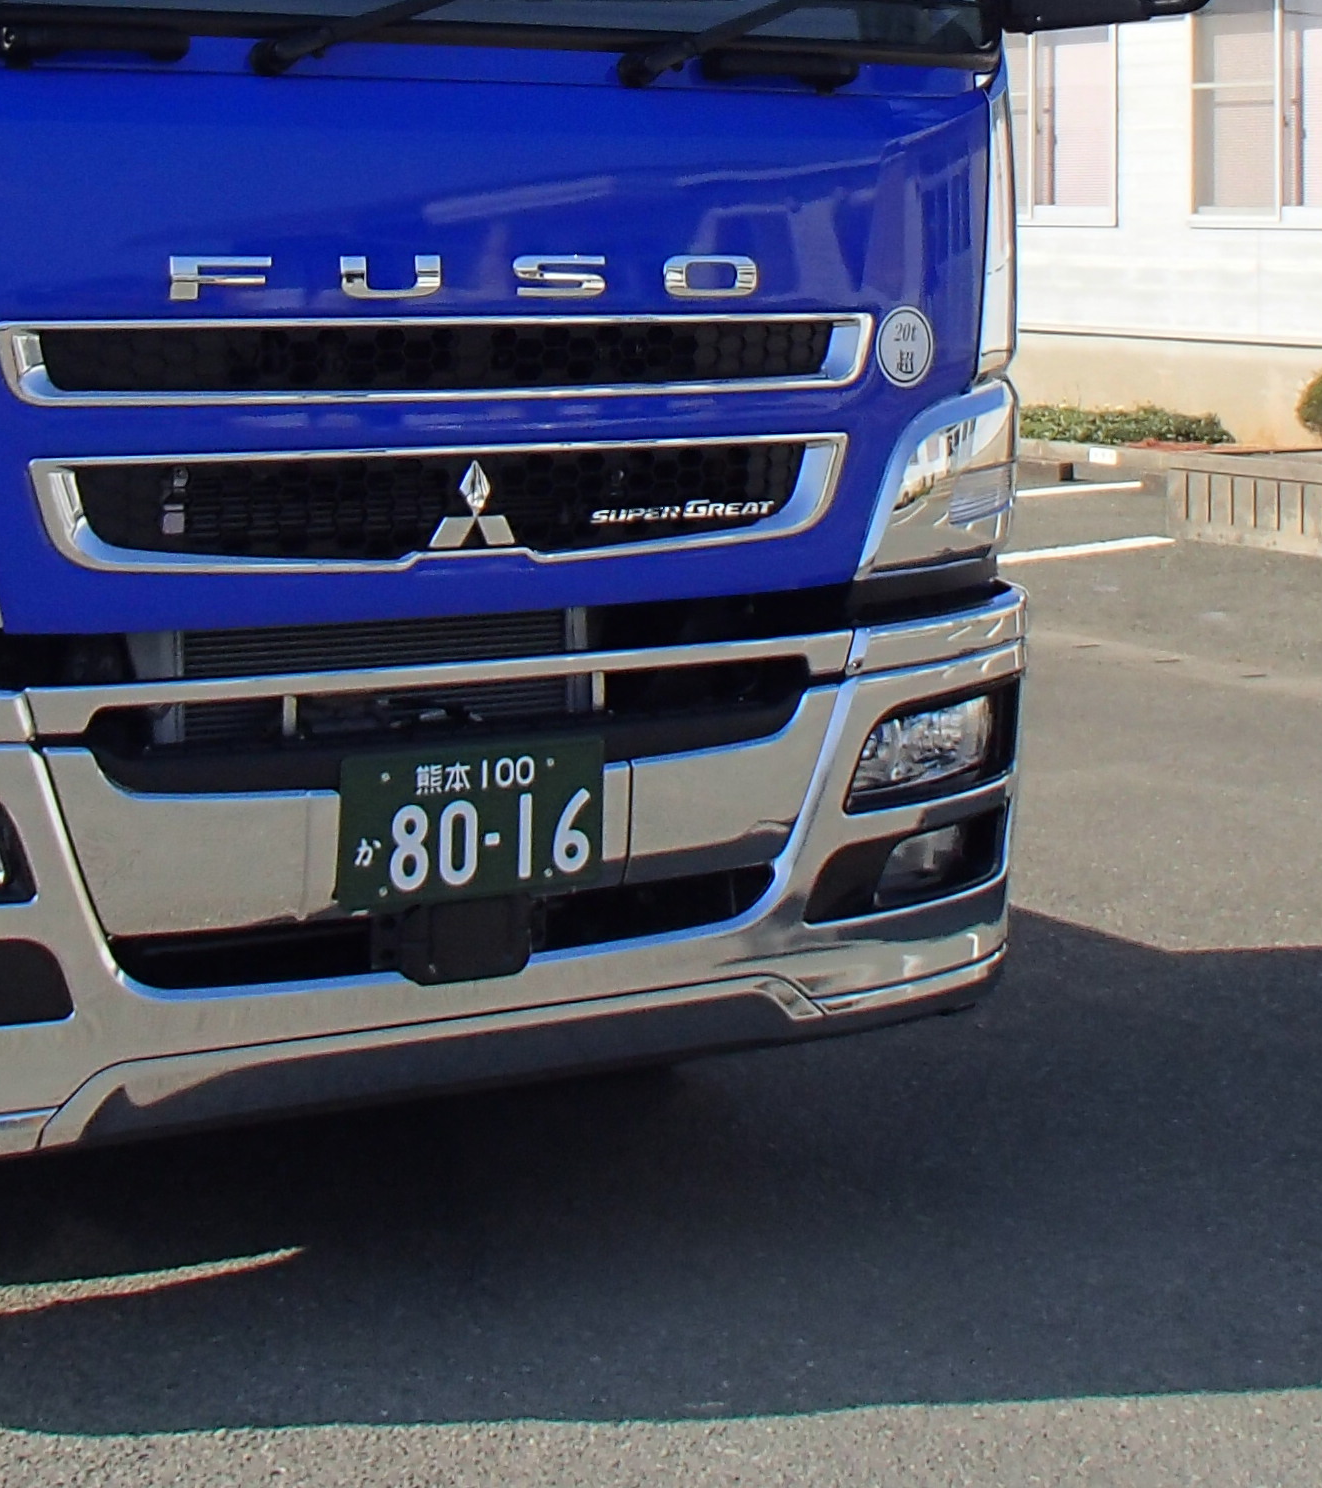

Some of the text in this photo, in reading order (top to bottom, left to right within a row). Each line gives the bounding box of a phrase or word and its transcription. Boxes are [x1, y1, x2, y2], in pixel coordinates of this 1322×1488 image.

[169, 254, 758, 301] FUSO
[893, 322, 917, 343] 20t
[896, 348, 915, 375] 超
[389, 787, 591, 892] 80-16
